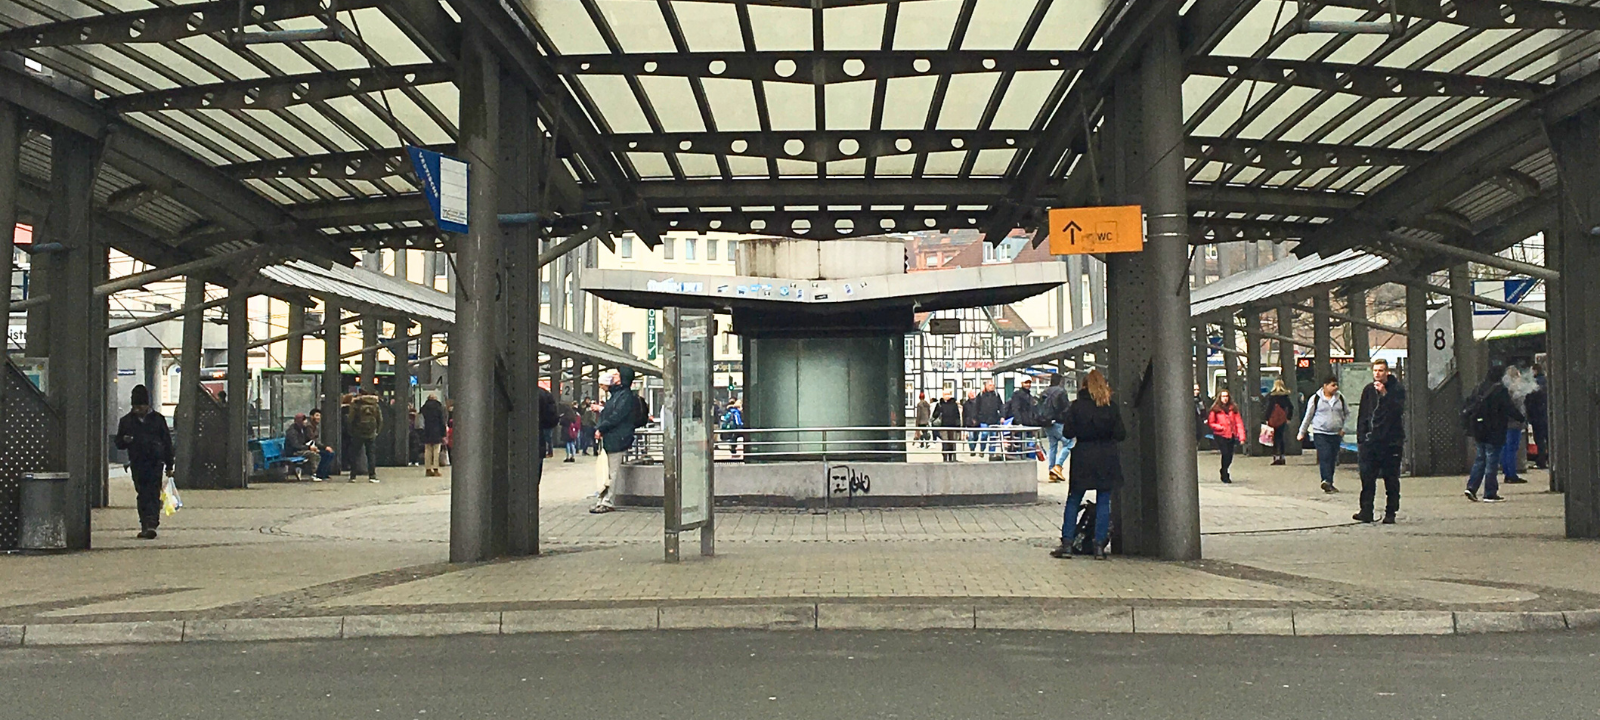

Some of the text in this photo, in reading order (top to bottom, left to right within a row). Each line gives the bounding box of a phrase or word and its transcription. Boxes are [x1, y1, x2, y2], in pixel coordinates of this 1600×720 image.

[1097, 232, 1113, 241] WC
[648, 308, 656, 343] OTEL
[1434, 328, 1446, 350] 8
[564, 385, 571, 396] 2
